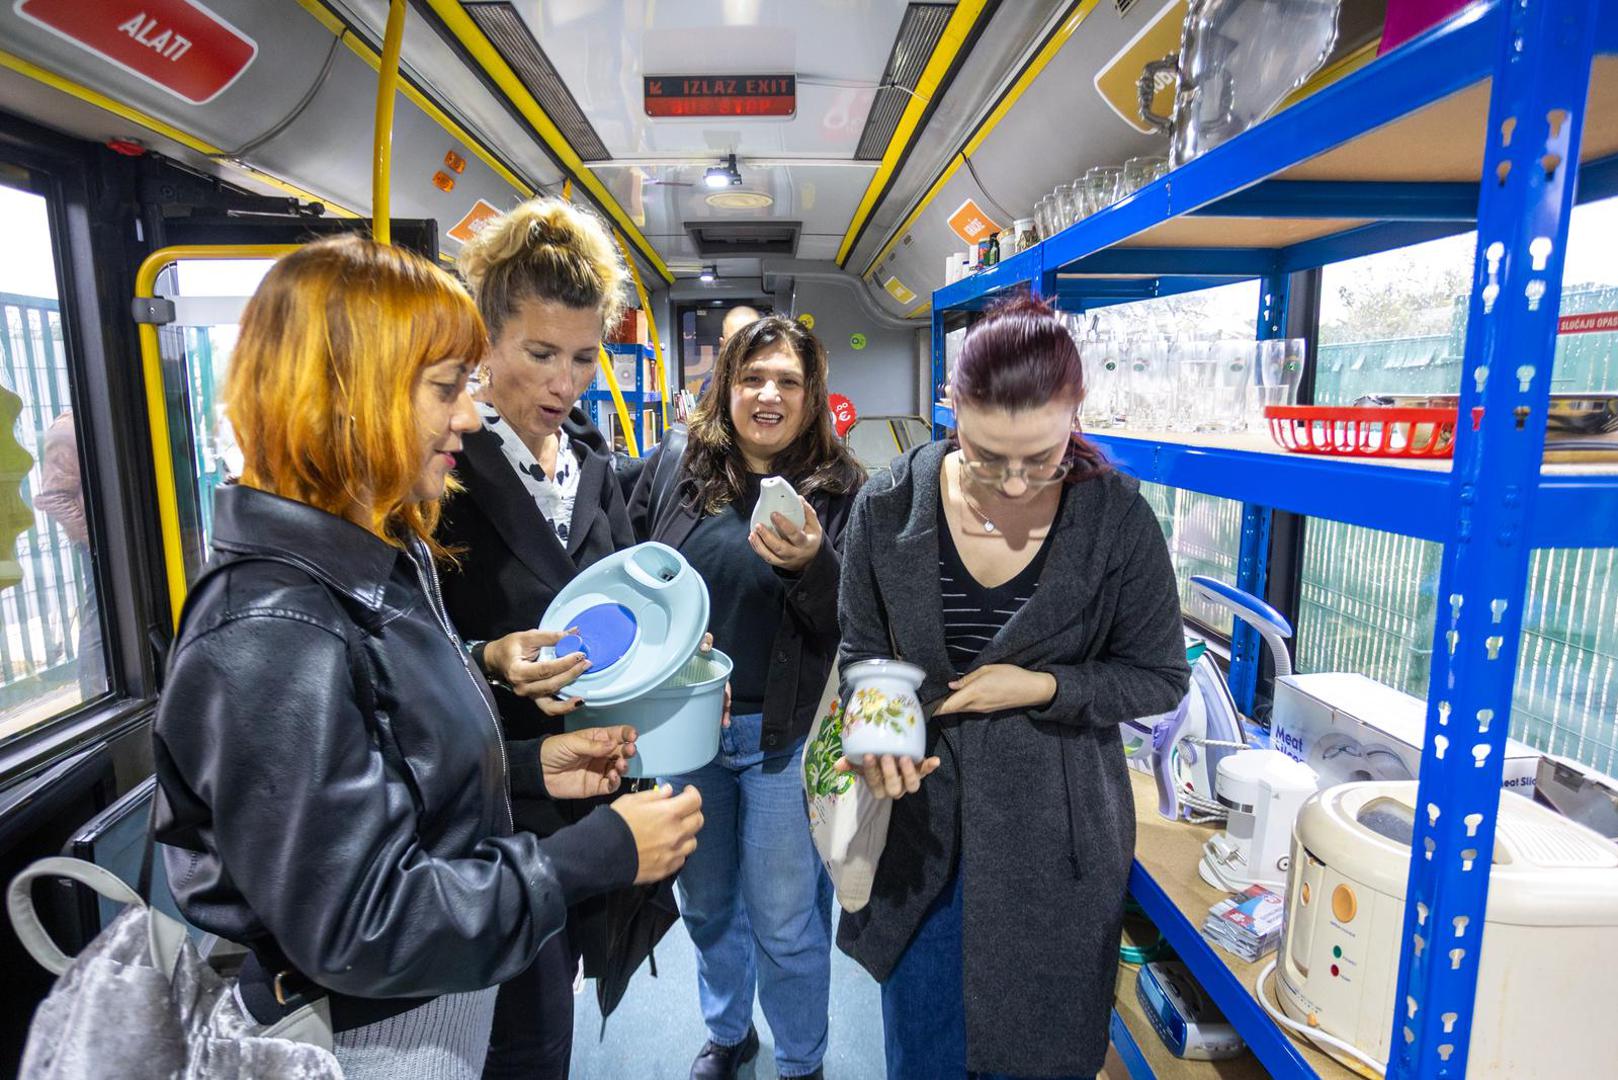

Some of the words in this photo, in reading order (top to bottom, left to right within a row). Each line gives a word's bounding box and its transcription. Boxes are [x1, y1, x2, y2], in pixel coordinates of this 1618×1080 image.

[117, 12, 193, 62] ALATI
[683, 79, 737, 94] IZLAZ
[746, 79, 789, 94] EXIT
[719, 99, 771, 114] STOP
[1275, 724, 1304, 752] Meat
[1502, 778, 1519, 787] eat
